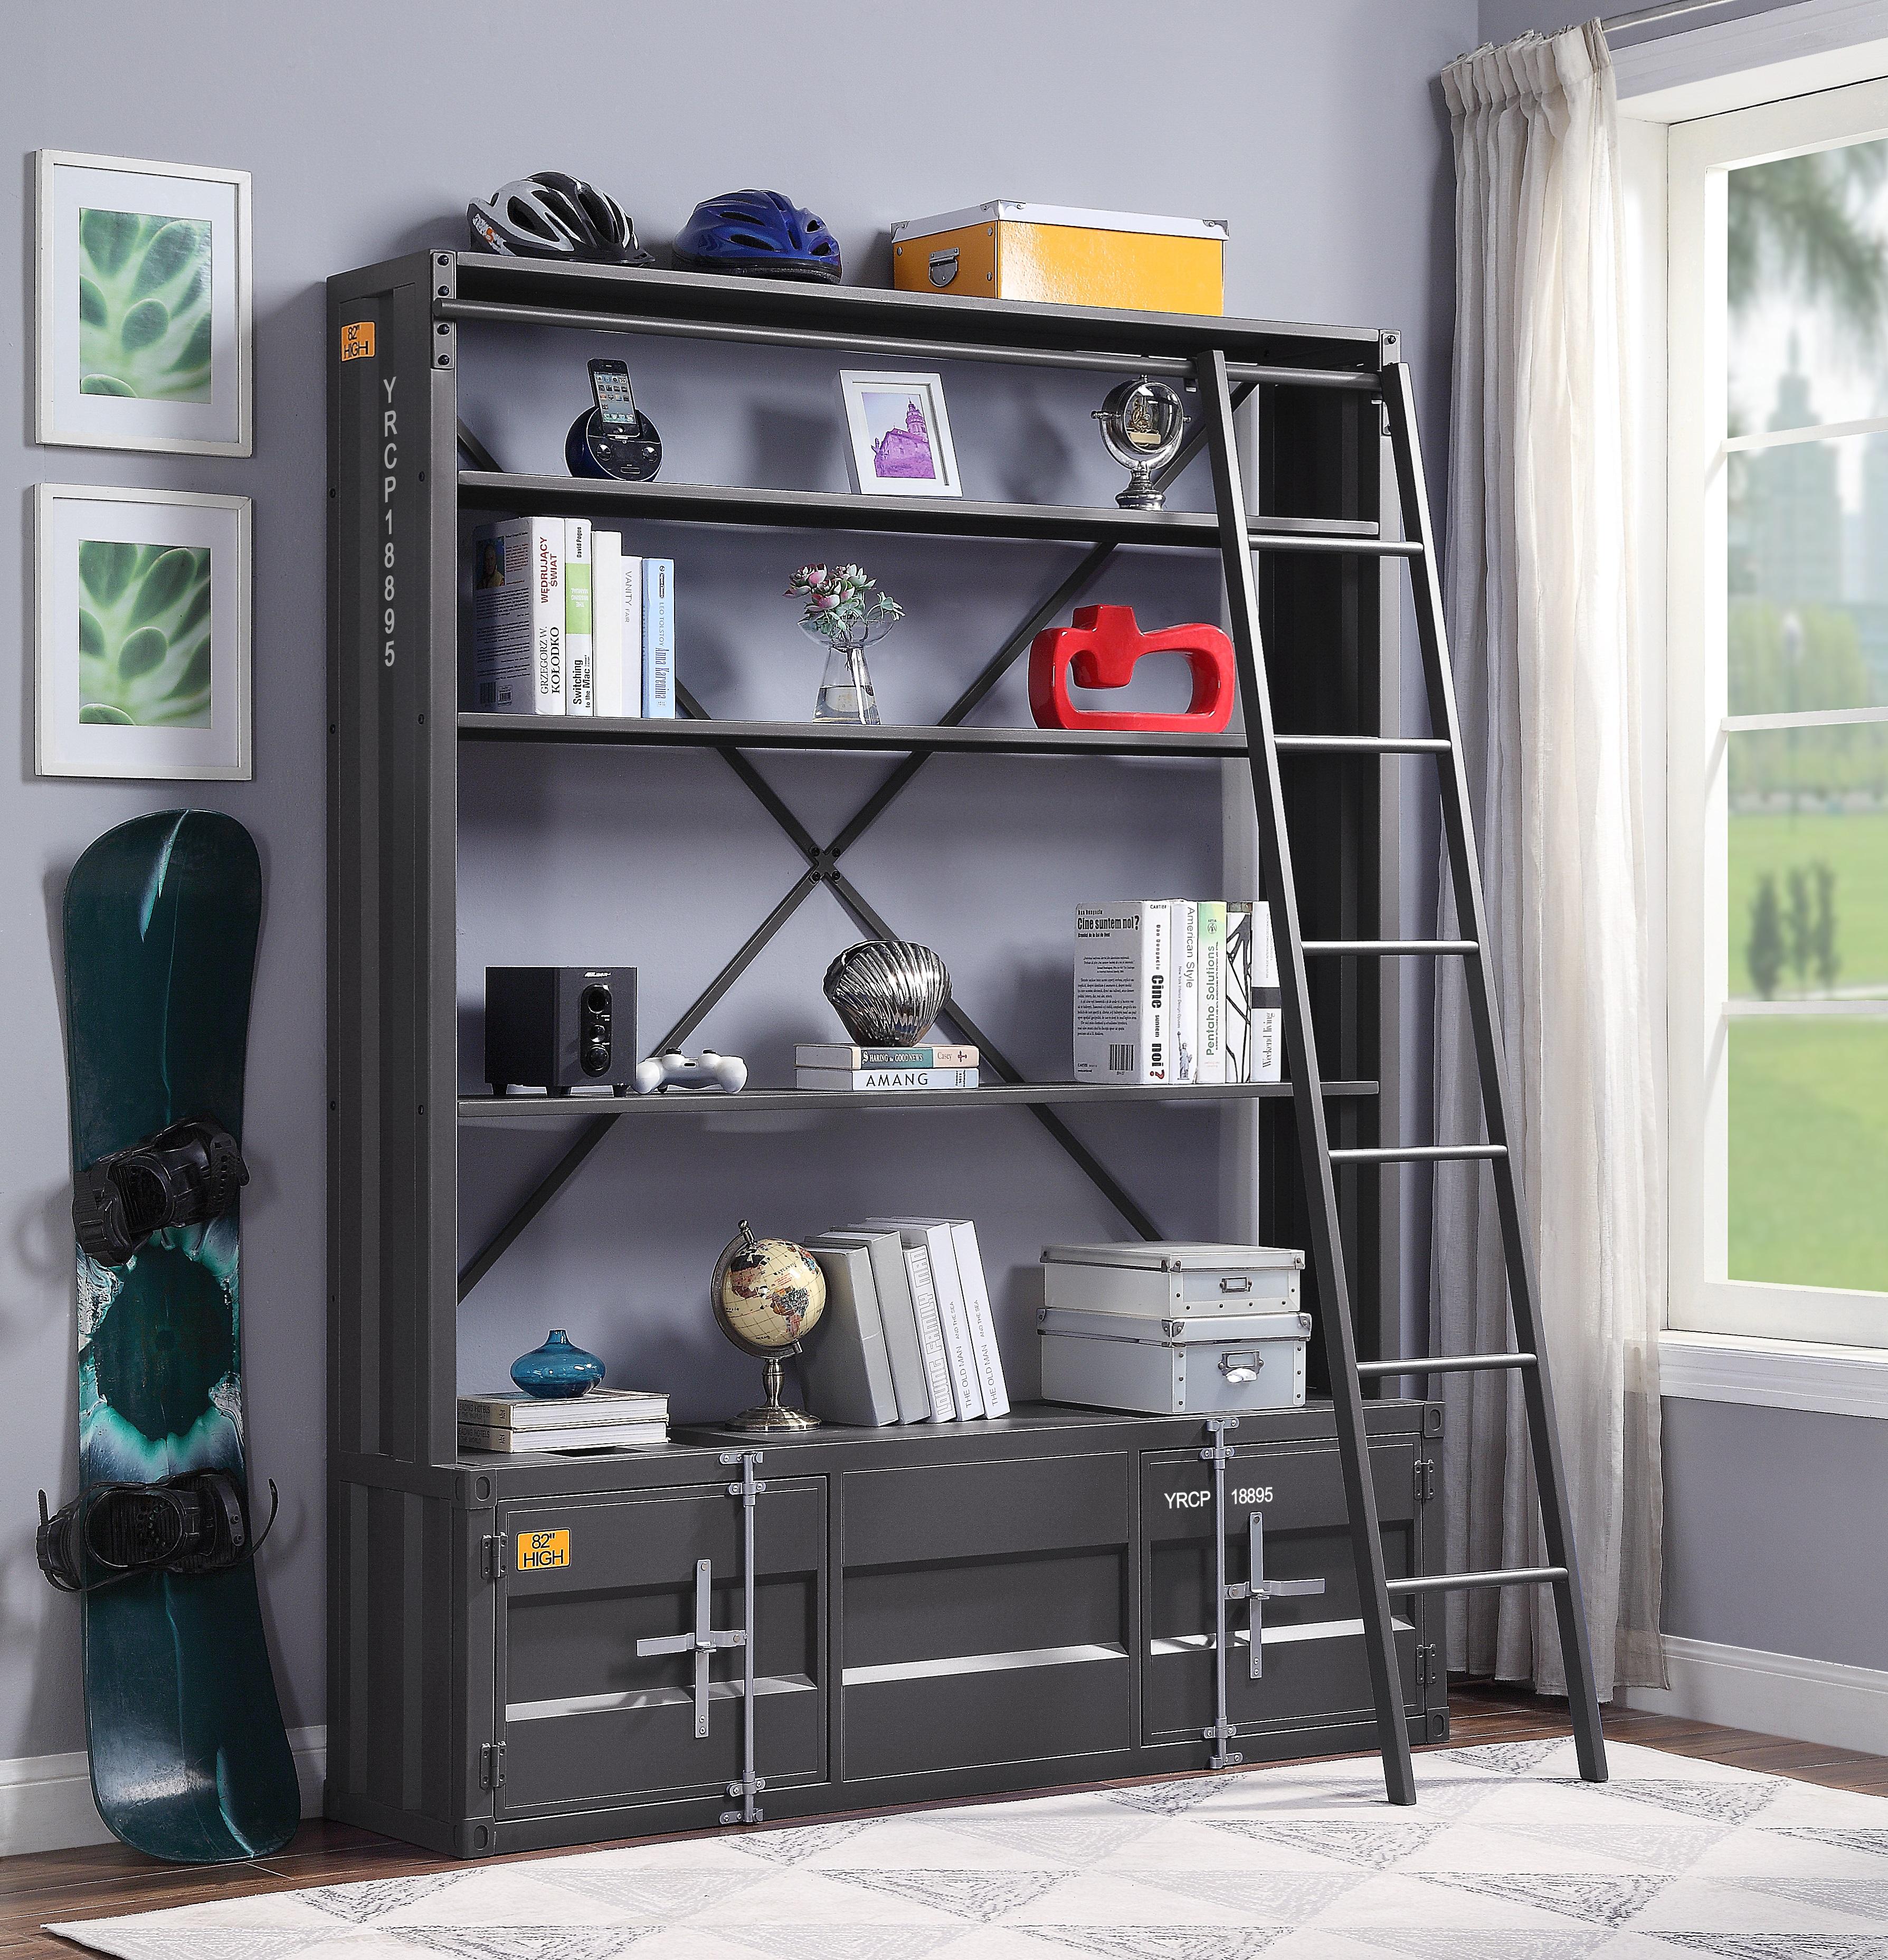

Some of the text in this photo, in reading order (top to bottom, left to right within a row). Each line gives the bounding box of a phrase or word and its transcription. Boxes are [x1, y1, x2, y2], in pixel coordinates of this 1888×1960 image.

[348, 325, 360, 340] 82"
[344, 340, 368, 358] HIGH
[540, 536, 549, 603] WĘDRUJĄCY
[549, 553, 558, 587] ŚWIAT
[549, 627, 561, 694] KOŁODKO
[655, 648, 669, 665] Anna
[572, 660, 583, 704] Switching
[582, 668, 591, 688] Mac
[655, 667, 669, 699] Karenina
[1077, 917, 1094, 930] Cine
[1095, 917, 1122, 930] suntem
[1184, 907, 1195, 988] American Style
[1206, 946, 1215, 1000] Solutions
[1152, 975, 1164, 1008] Cine
[1206, 1006, 1215, 1055] Pentaho
[1262, 1012, 1275, 1068] Weekend living
[895, 1054, 909, 1062] GOOD
[937, 1052, 952, 1061] Casey
[866, 1073, 928, 1087] AMANG
[909, 1248, 931, 1287] MAN
[917, 1292, 942, 1354] FAMILY
[955, 1346, 965, 1366] MAN
[981, 1344, 990, 1365] MAN
[959, 1368, 969, 1387] OLD
[985, 1367, 994, 1386] OLD
[963, 1389, 972, 1408] THE
[990, 1387, 999, 1406] THE
[474, 1429, 490, 1438] HOTELS
[1164, 1486, 1273, 1509] YRCP 18895
[532, 1532, 556, 1549] 82"
[523, 1549, 564, 1568] HIGH
